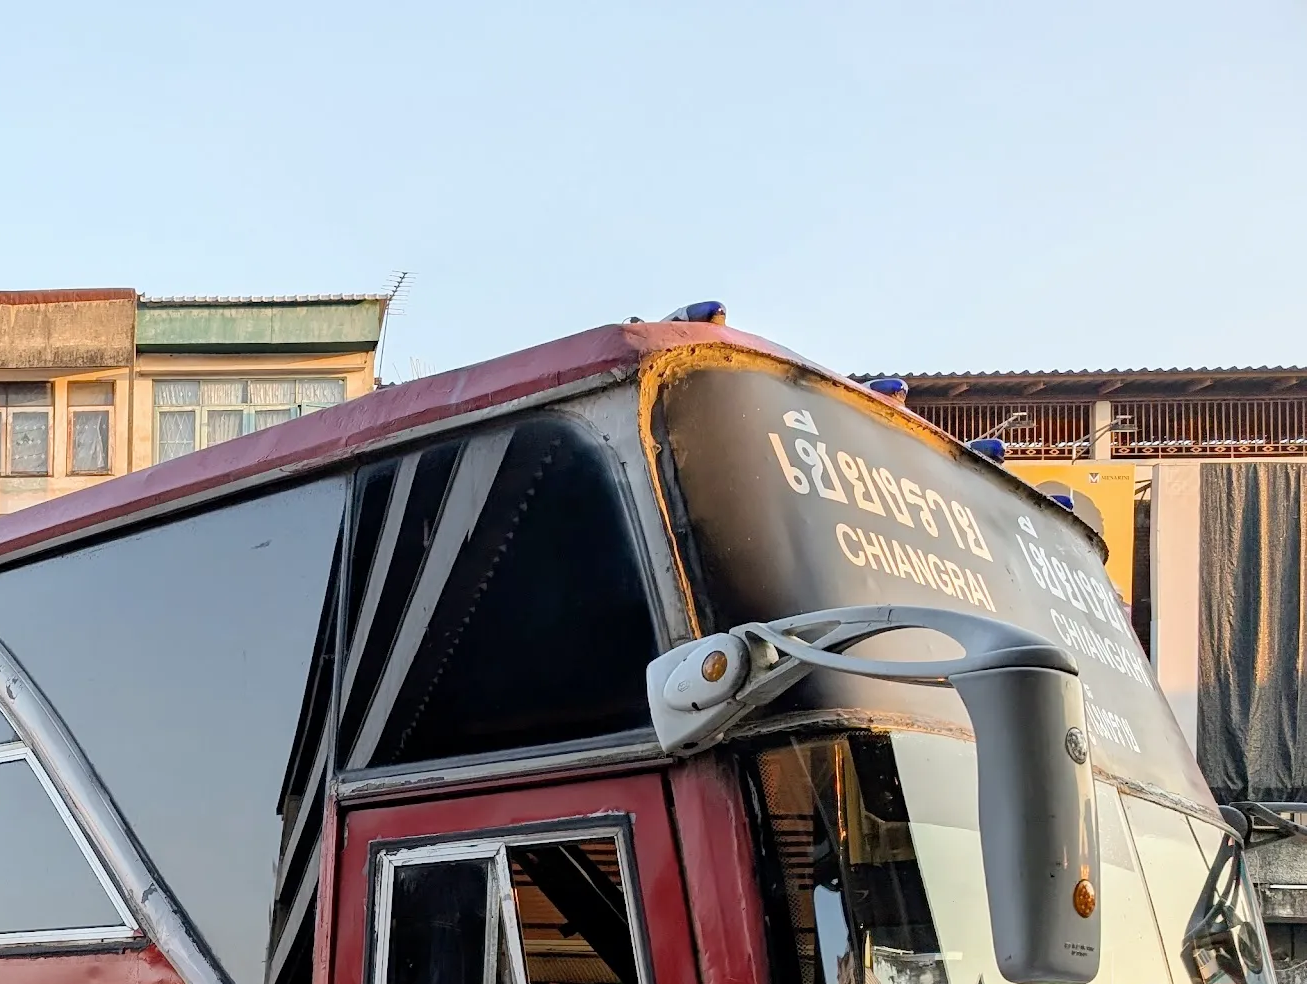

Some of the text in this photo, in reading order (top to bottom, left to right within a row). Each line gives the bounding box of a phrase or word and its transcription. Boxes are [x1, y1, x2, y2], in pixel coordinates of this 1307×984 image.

[768, 410, 993, 562] เชียงราย
[835, 523, 997, 612] CHIANGRAI
